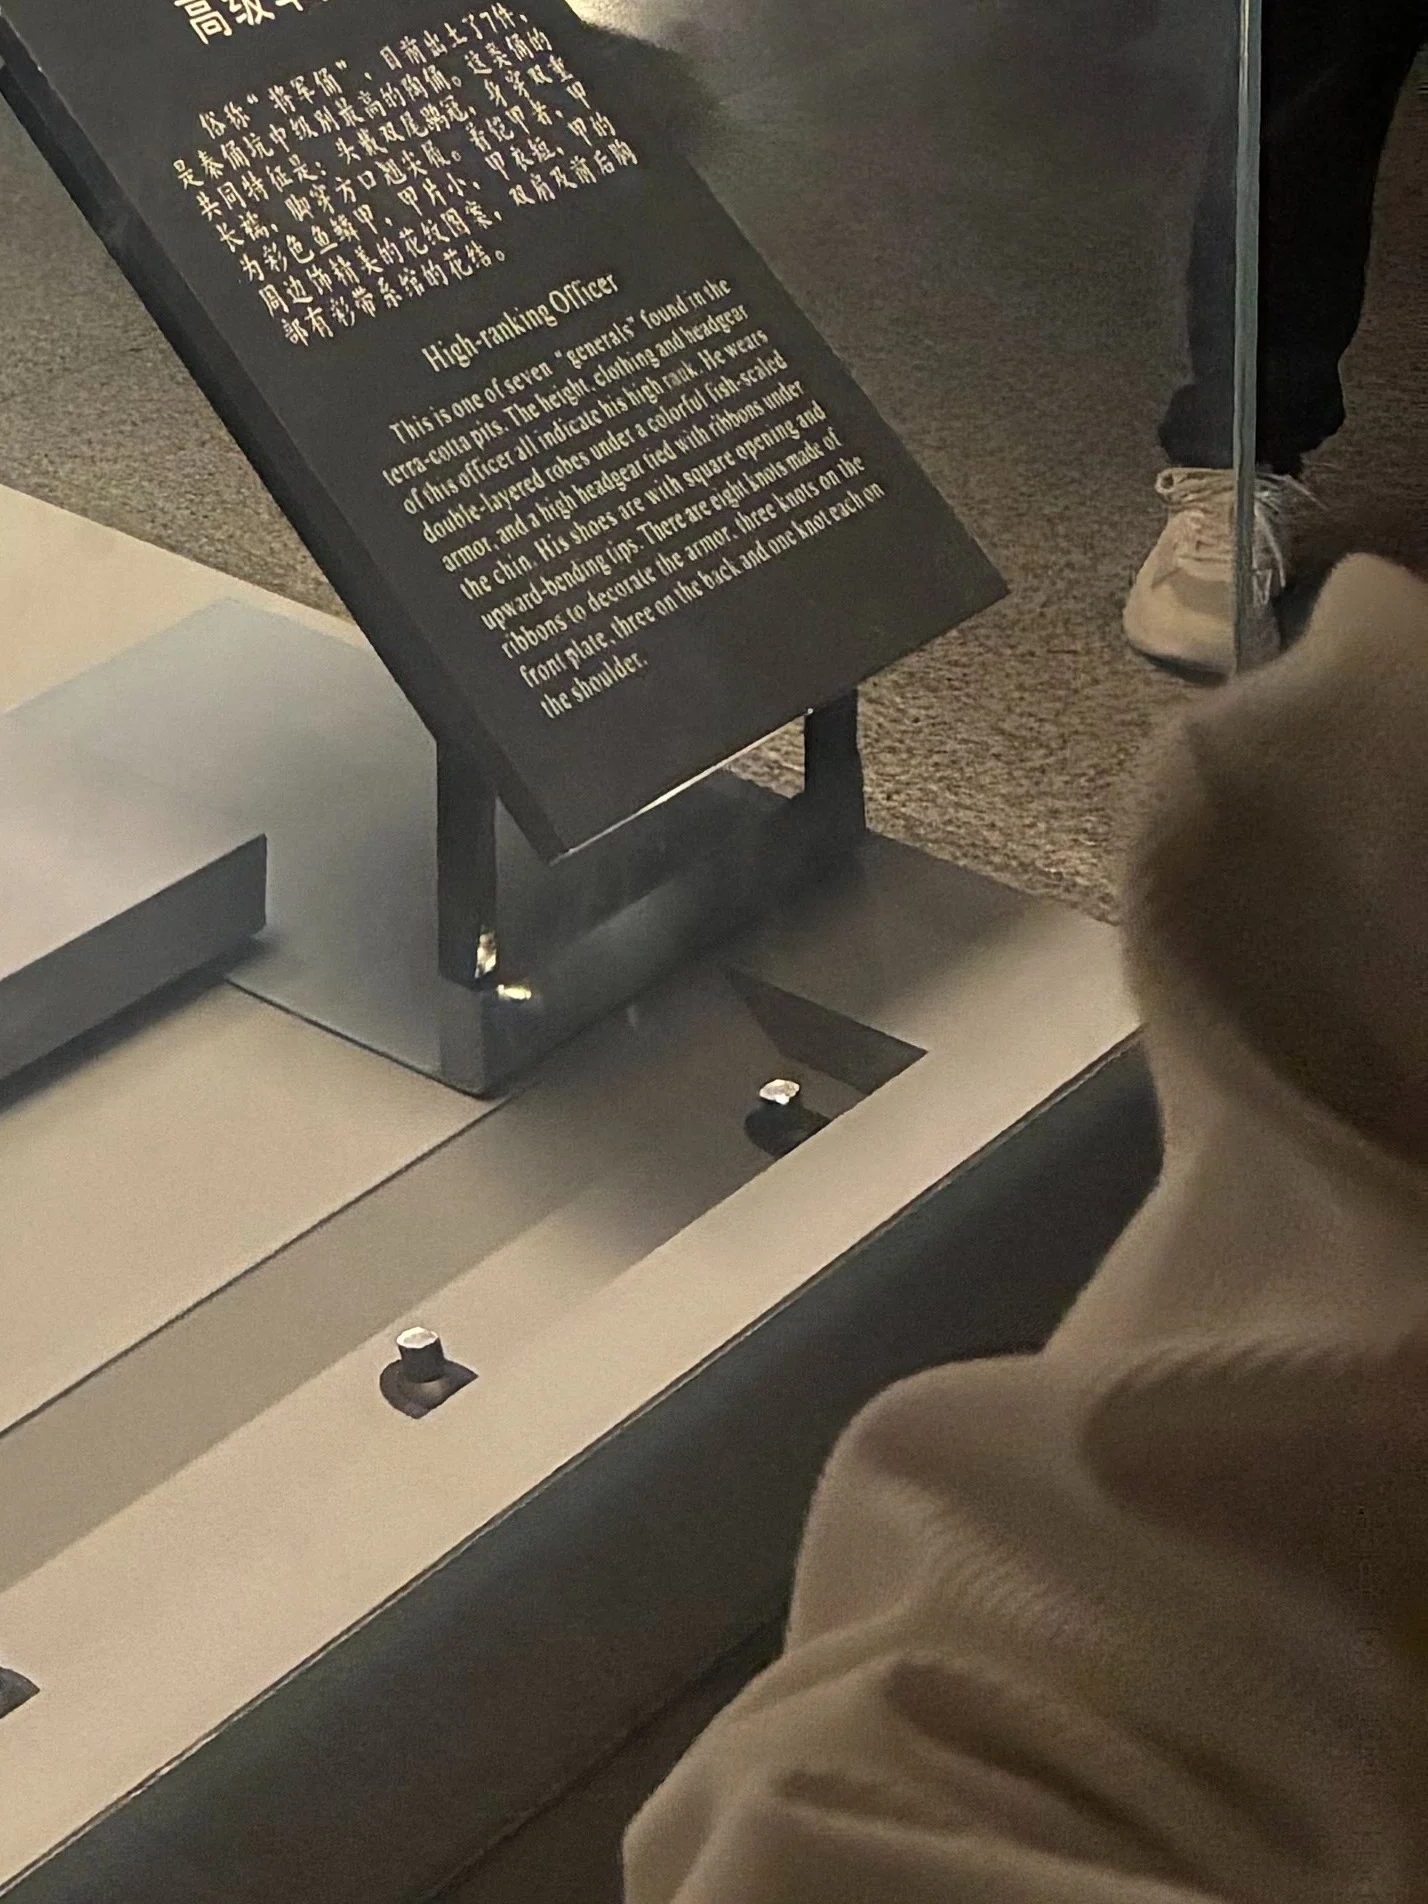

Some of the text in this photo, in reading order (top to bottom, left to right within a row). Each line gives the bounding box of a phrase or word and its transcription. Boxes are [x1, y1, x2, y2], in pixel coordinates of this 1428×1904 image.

[381, 434, 473, 488] terra-cotta
[468, 419, 510, 452] pits.
[501, 402, 542, 428] The
[592, 347, 661, 388] clothing
[654, 328, 687, 359] and
[677, 304, 749, 345] headgear
[388, 414, 436, 445] This
[428, 405, 453, 428] is
[450, 392, 486, 419] one
[483, 376, 506, 404] of
[503, 361, 554, 395] seven
[639, 293, 690, 331] found
[683, 289, 708, 310] in
[702, 278, 732, 302] the
[420, 273, 619, 373] High-ranking Officer
[402, 486, 426, 515] of
[421, 477, 460, 505] this
[457, 449, 516, 489] officer
[513, 433, 541, 462] all
[532, 408, 604, 451] indicate
[596, 393, 629, 420] his
[620, 375, 666, 407] high
[696, 348, 727, 372] He
[722, 329, 769, 359] wears
[421, 348, 789, 545] double-layered robes under a colorful fish-scaled
[459, 399, 827, 601] the chin. His shoes are with square opening and
[495, 512, 531, 545] and
[526, 512, 542, 529] a
[534, 489, 579, 524] high
[569, 458, 646, 505] headgear
[641, 438, 678, 471] tied
[673, 423, 713, 455] with
[707, 399, 766, 438] ribbons
[761, 379, 805, 411] under
[480, 425, 843, 632] upward-bending tips. There are eight knots made of
[500, 613, 569, 660] ribbons
[564, 603, 588, 624] to
[586, 566, 658, 613] decorate
[654, 551, 685, 577] the
[733, 502, 778, 535] three
[770, 480, 821, 514] knots
[818, 469, 842, 491] on
[836, 456, 866, 479] the
[518, 482, 886, 689] front plate, three on the back and one knot each on
[539, 652, 649, 719] the shoulder.
